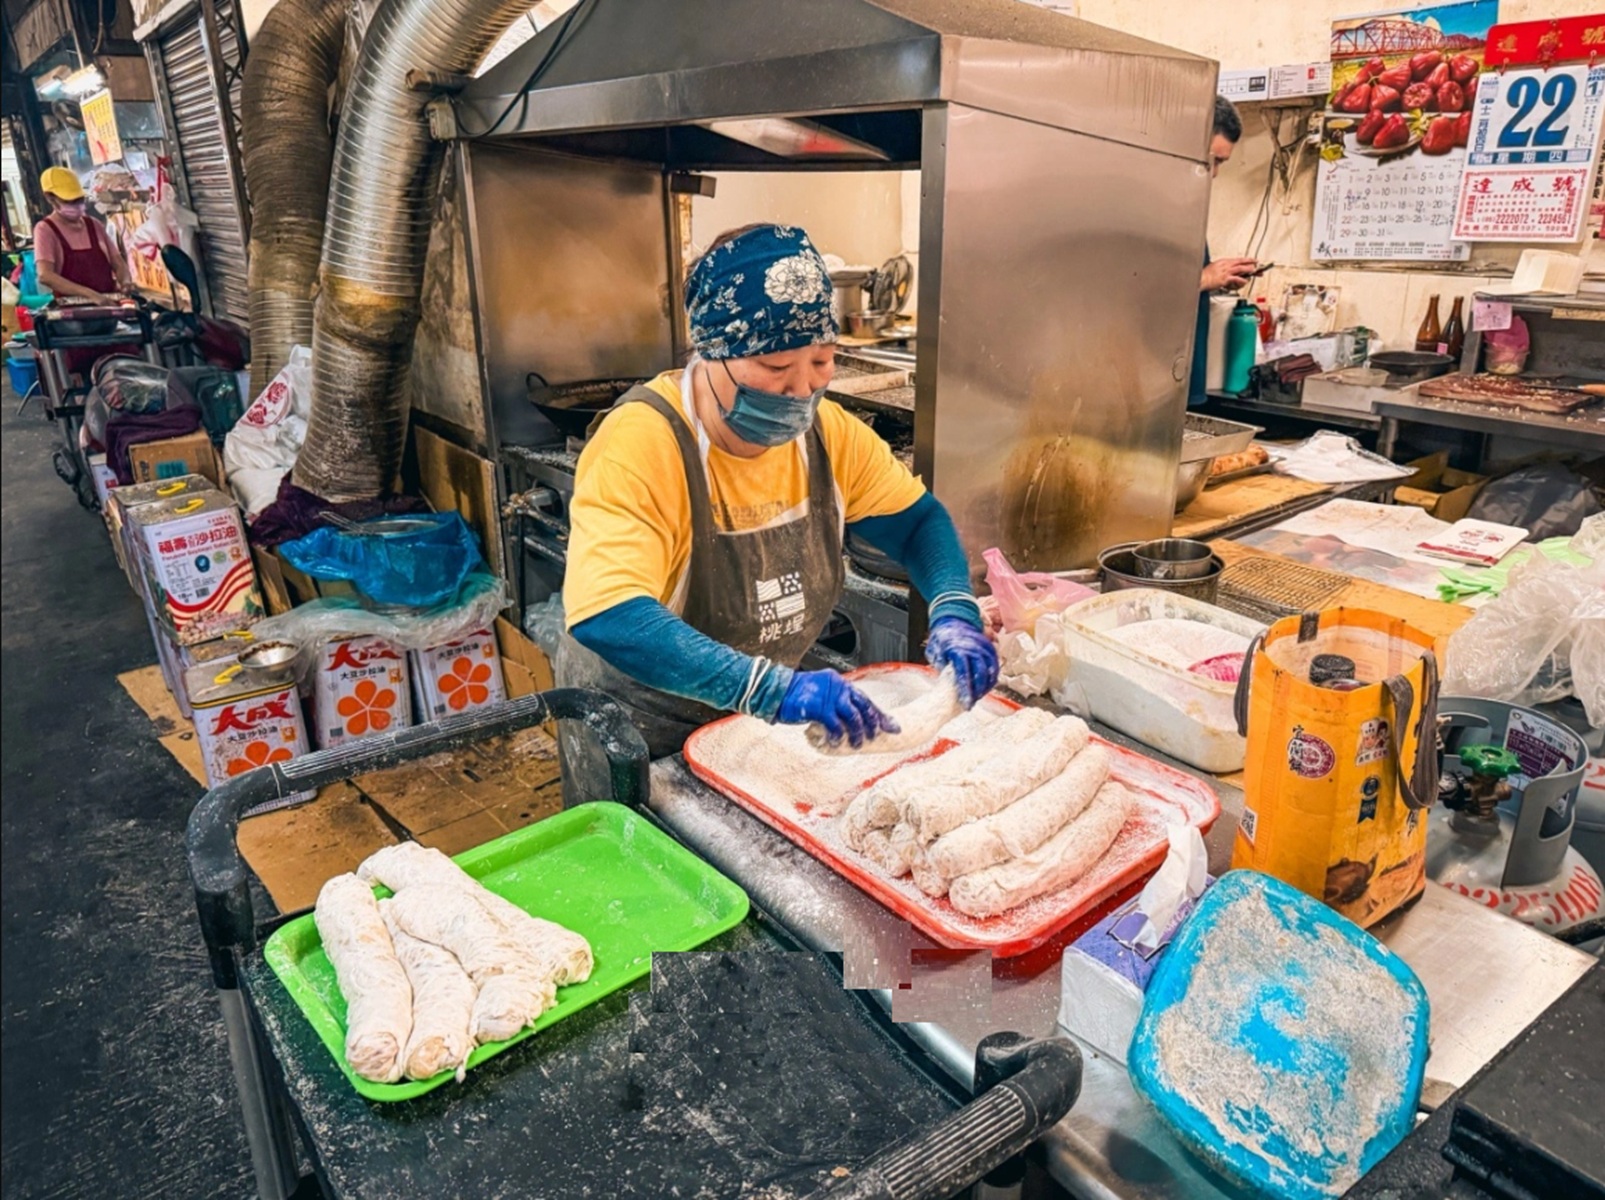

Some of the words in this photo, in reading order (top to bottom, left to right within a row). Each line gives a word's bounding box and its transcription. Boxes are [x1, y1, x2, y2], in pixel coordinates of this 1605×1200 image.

[1497, 73, 1577, 148] 22
[1472, 175, 1577, 194] 達成號
[209, 691, 296, 736] 大成
